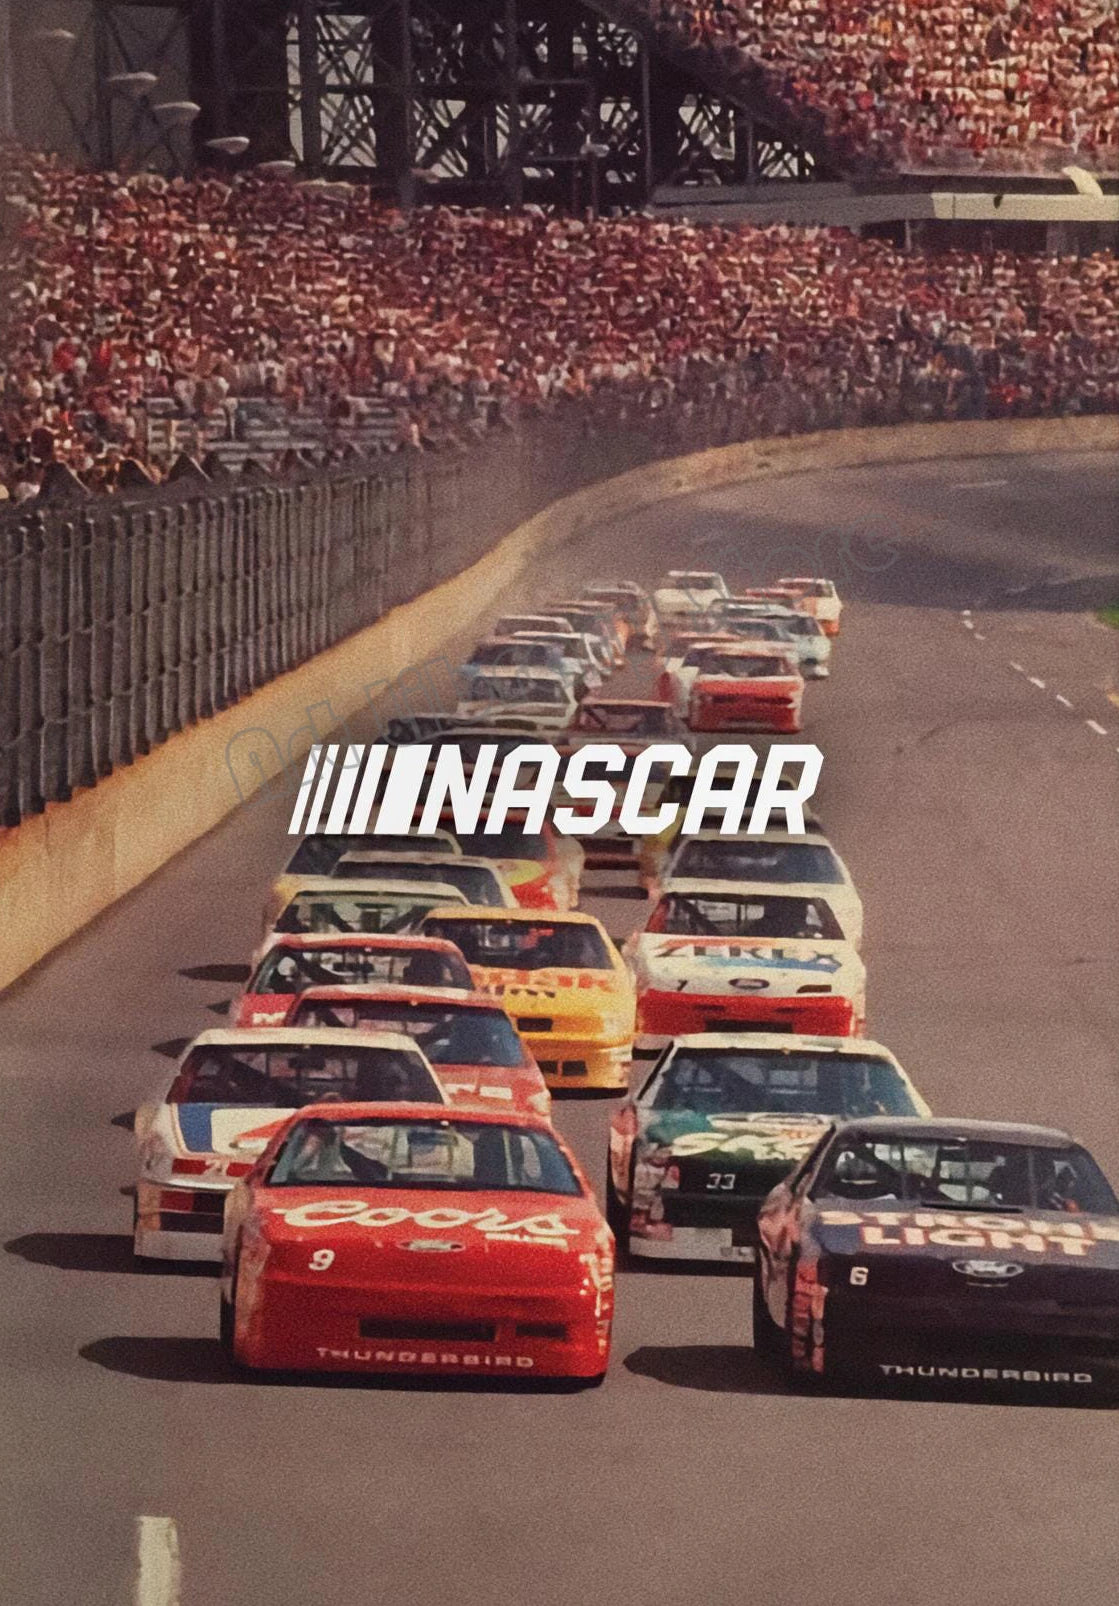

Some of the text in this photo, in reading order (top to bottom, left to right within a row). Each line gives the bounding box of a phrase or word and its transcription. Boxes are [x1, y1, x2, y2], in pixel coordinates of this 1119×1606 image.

[706, 1173, 736, 1190] 33
[271, 1200, 580, 1236] Coors
[861, 1226, 1097, 1257] LIGHT
[308, 1249, 335, 1271] 9
[849, 1266, 869, 1286] 6
[316, 1347, 534, 1368] THUNDERBIRD
[879, 1364, 1093, 1383] THUNDERBIRD
